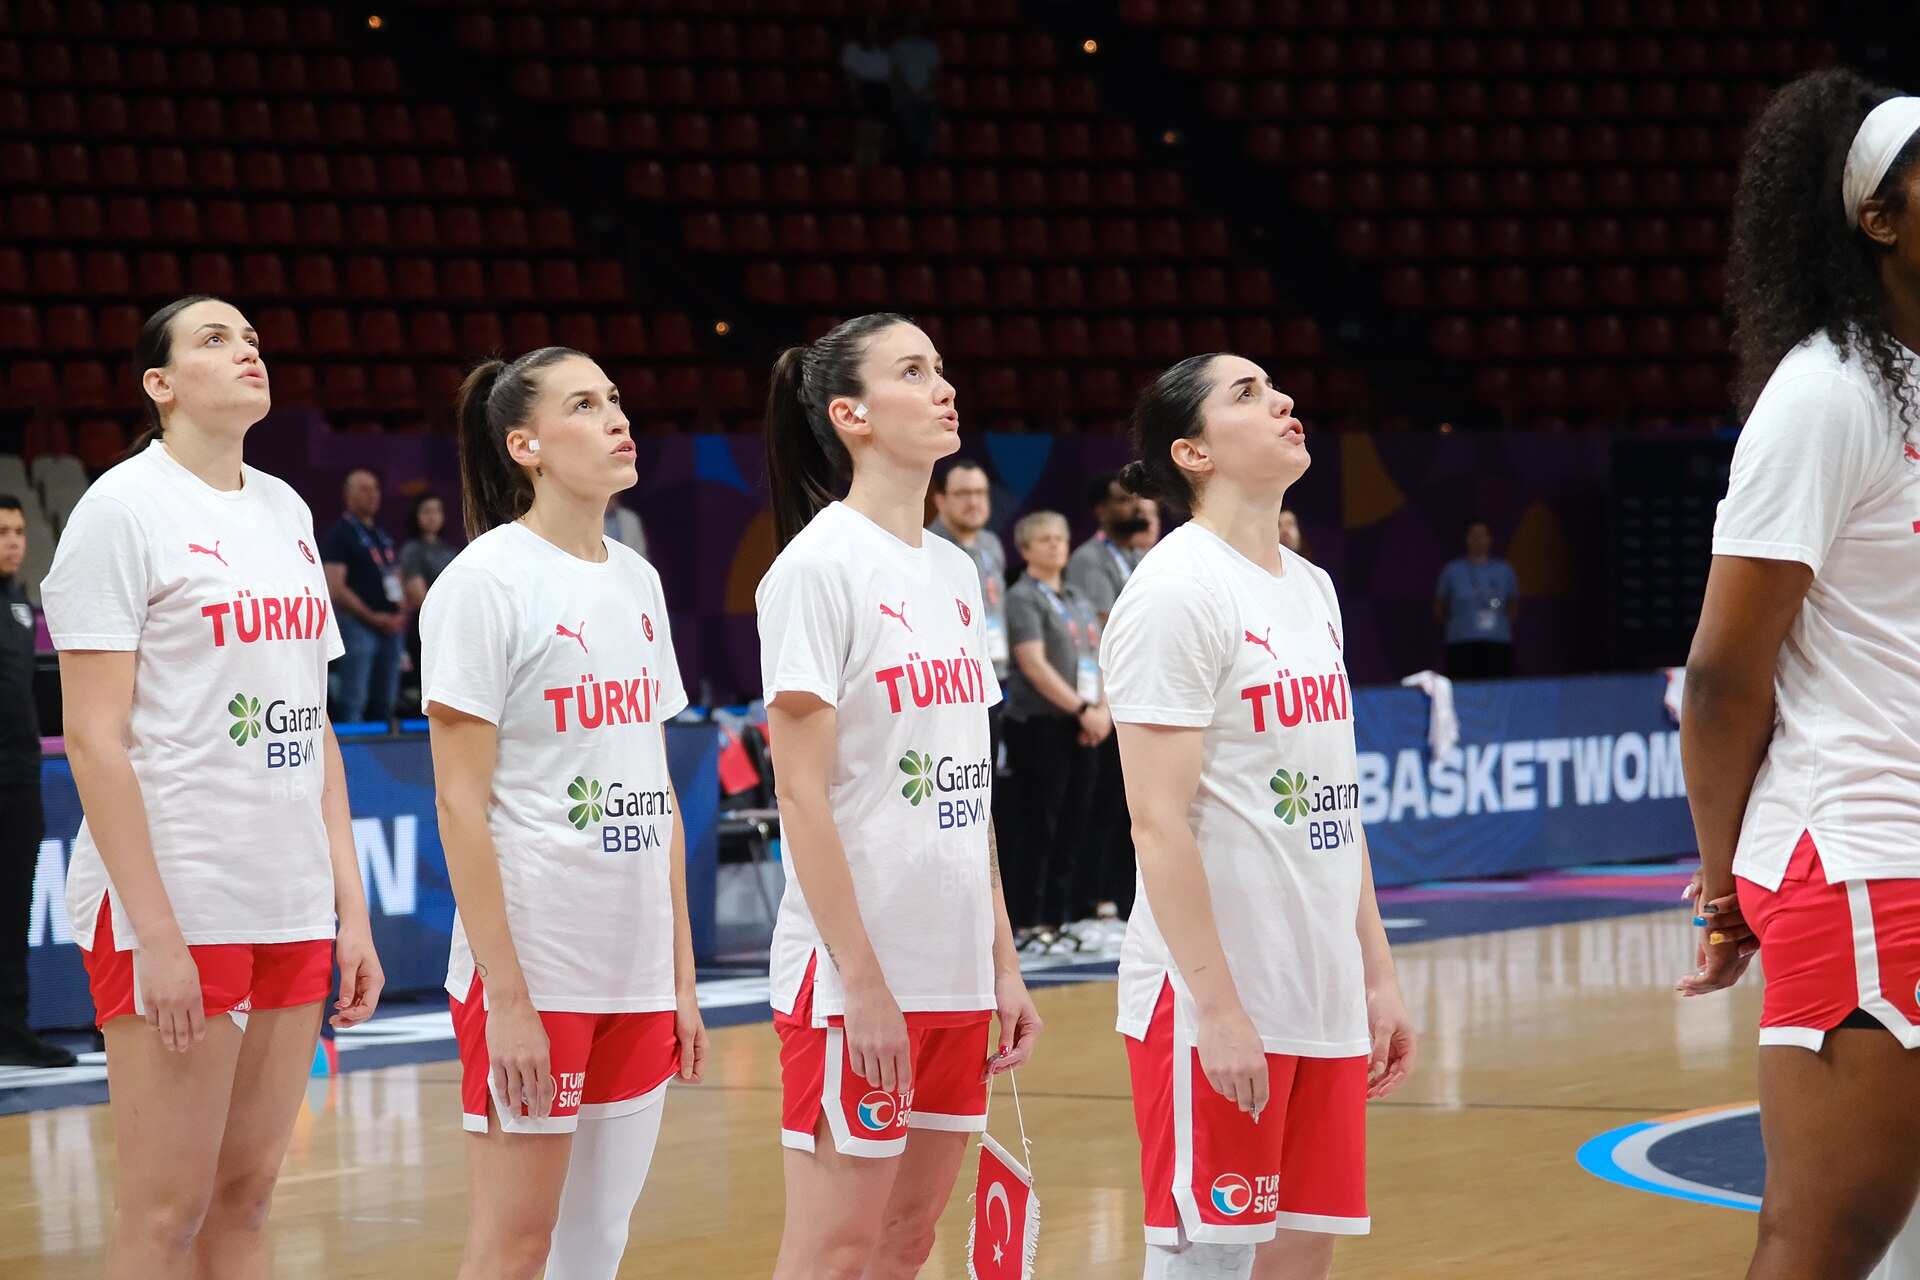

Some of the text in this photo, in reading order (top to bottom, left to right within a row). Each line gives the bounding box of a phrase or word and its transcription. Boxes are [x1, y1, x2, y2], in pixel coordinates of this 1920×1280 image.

[1241, 662, 1351, 733] TÜRKİ
[267, 737, 315, 768] BBVA
[938, 794, 985, 829] BBVA
[603, 822, 661, 852] BBVA
[1310, 817, 1354, 850] BBVA
